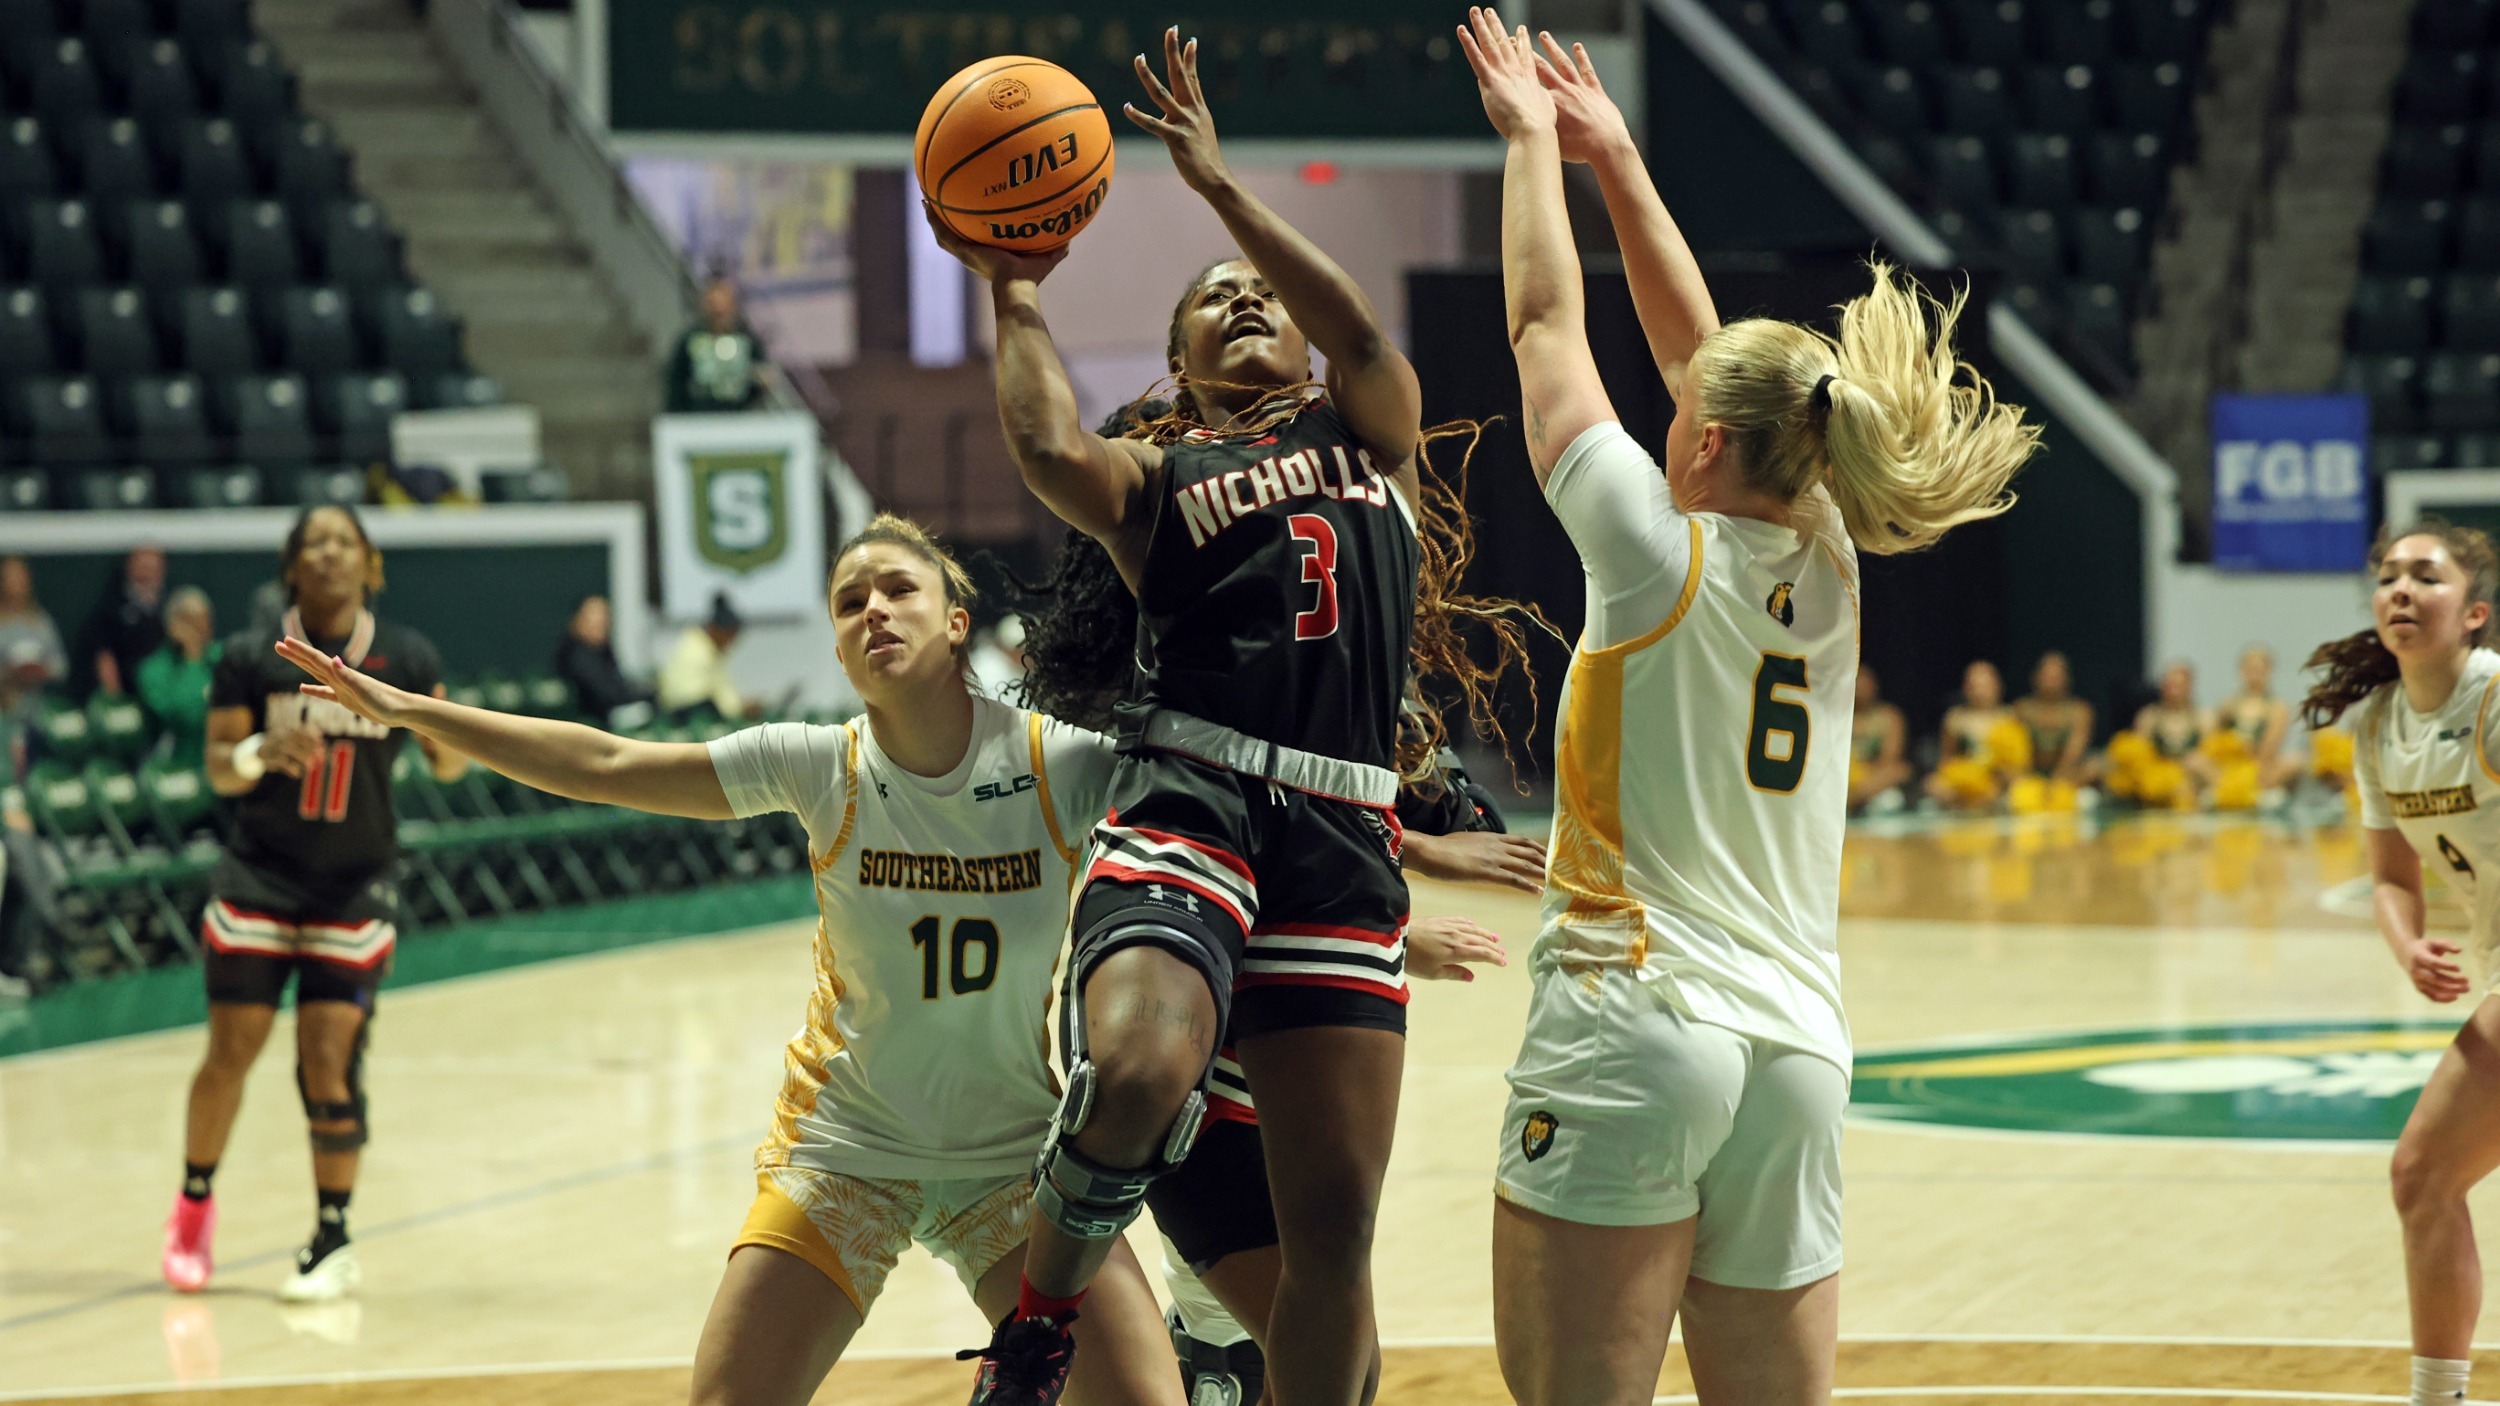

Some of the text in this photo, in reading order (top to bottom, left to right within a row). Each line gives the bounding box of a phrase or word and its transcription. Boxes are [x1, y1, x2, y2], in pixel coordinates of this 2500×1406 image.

[983, 183, 1007, 198] NXT
[989, 175, 1109, 240] Wilson
[709, 469, 771, 550] S
[1175, 445, 1388, 549] NICHOLLS
[2217, 439, 2362, 499] FGB
[1287, 513, 1339, 642] 3
[1744, 650, 1812, 796] 6
[298, 738, 356, 822] 11
[973, 773, 1037, 802] SLC
[859, 847, 1042, 895] SOUTHEASTERN
[908, 914, 1001, 1001] 10
